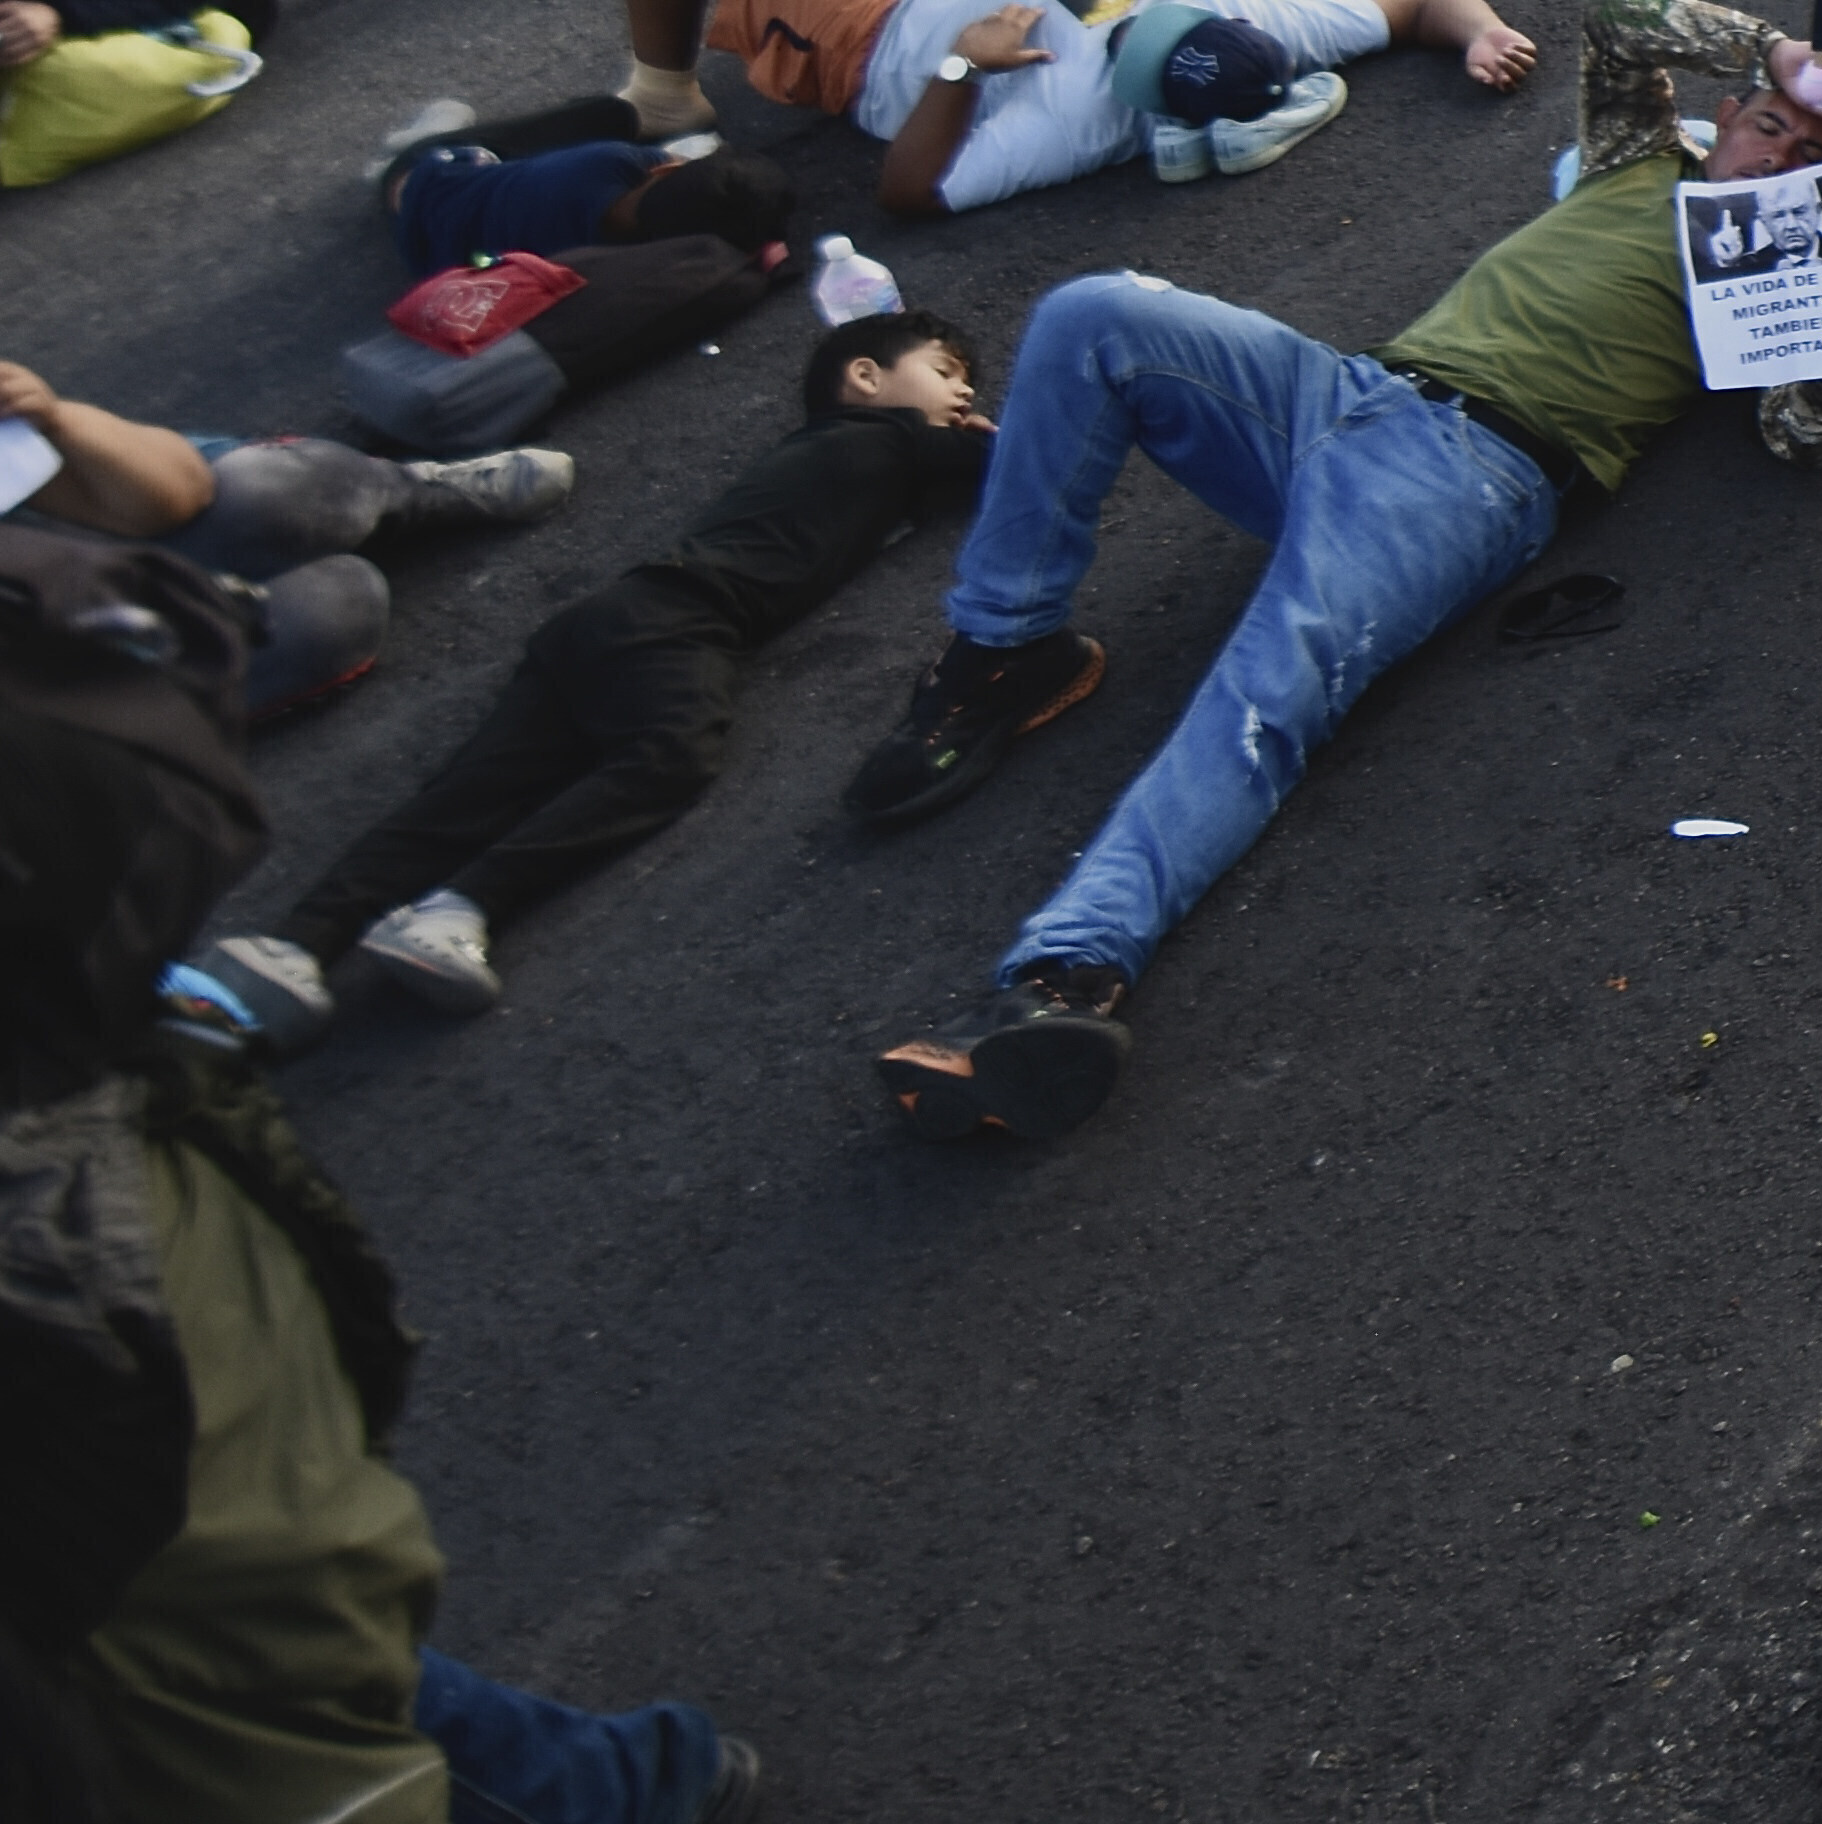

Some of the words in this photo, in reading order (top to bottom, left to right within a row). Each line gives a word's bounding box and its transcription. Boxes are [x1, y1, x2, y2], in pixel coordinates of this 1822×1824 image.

[1711, 287, 1736, 302] LA
[1741, 277, 1788, 295] VIDA
[1795, 273, 1818, 288] DE
